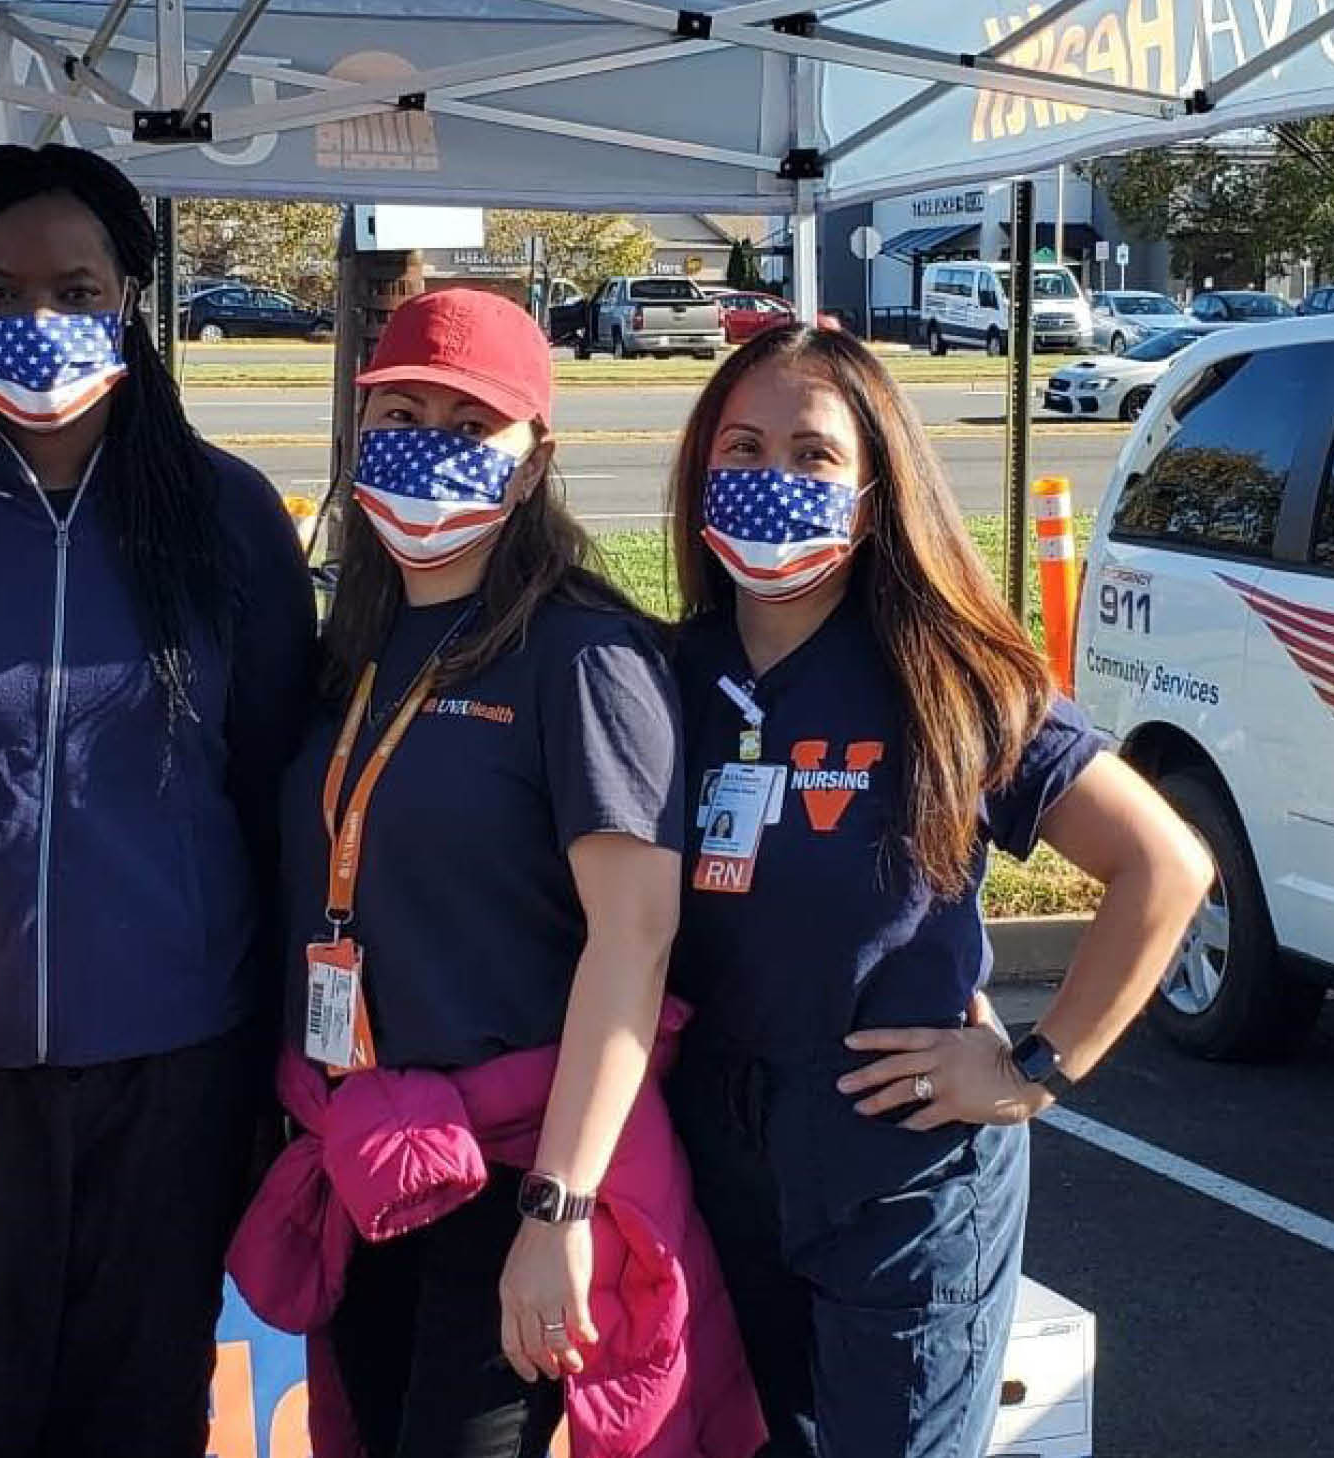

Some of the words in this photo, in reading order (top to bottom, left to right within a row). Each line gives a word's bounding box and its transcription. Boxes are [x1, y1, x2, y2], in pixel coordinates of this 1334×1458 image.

[1100, 584, 1150, 634] 911
[1086, 645, 1150, 695] Community
[1153, 664, 1220, 706] Services
[791, 770, 870, 790] NURSING
[705, 862, 744, 888] RN
